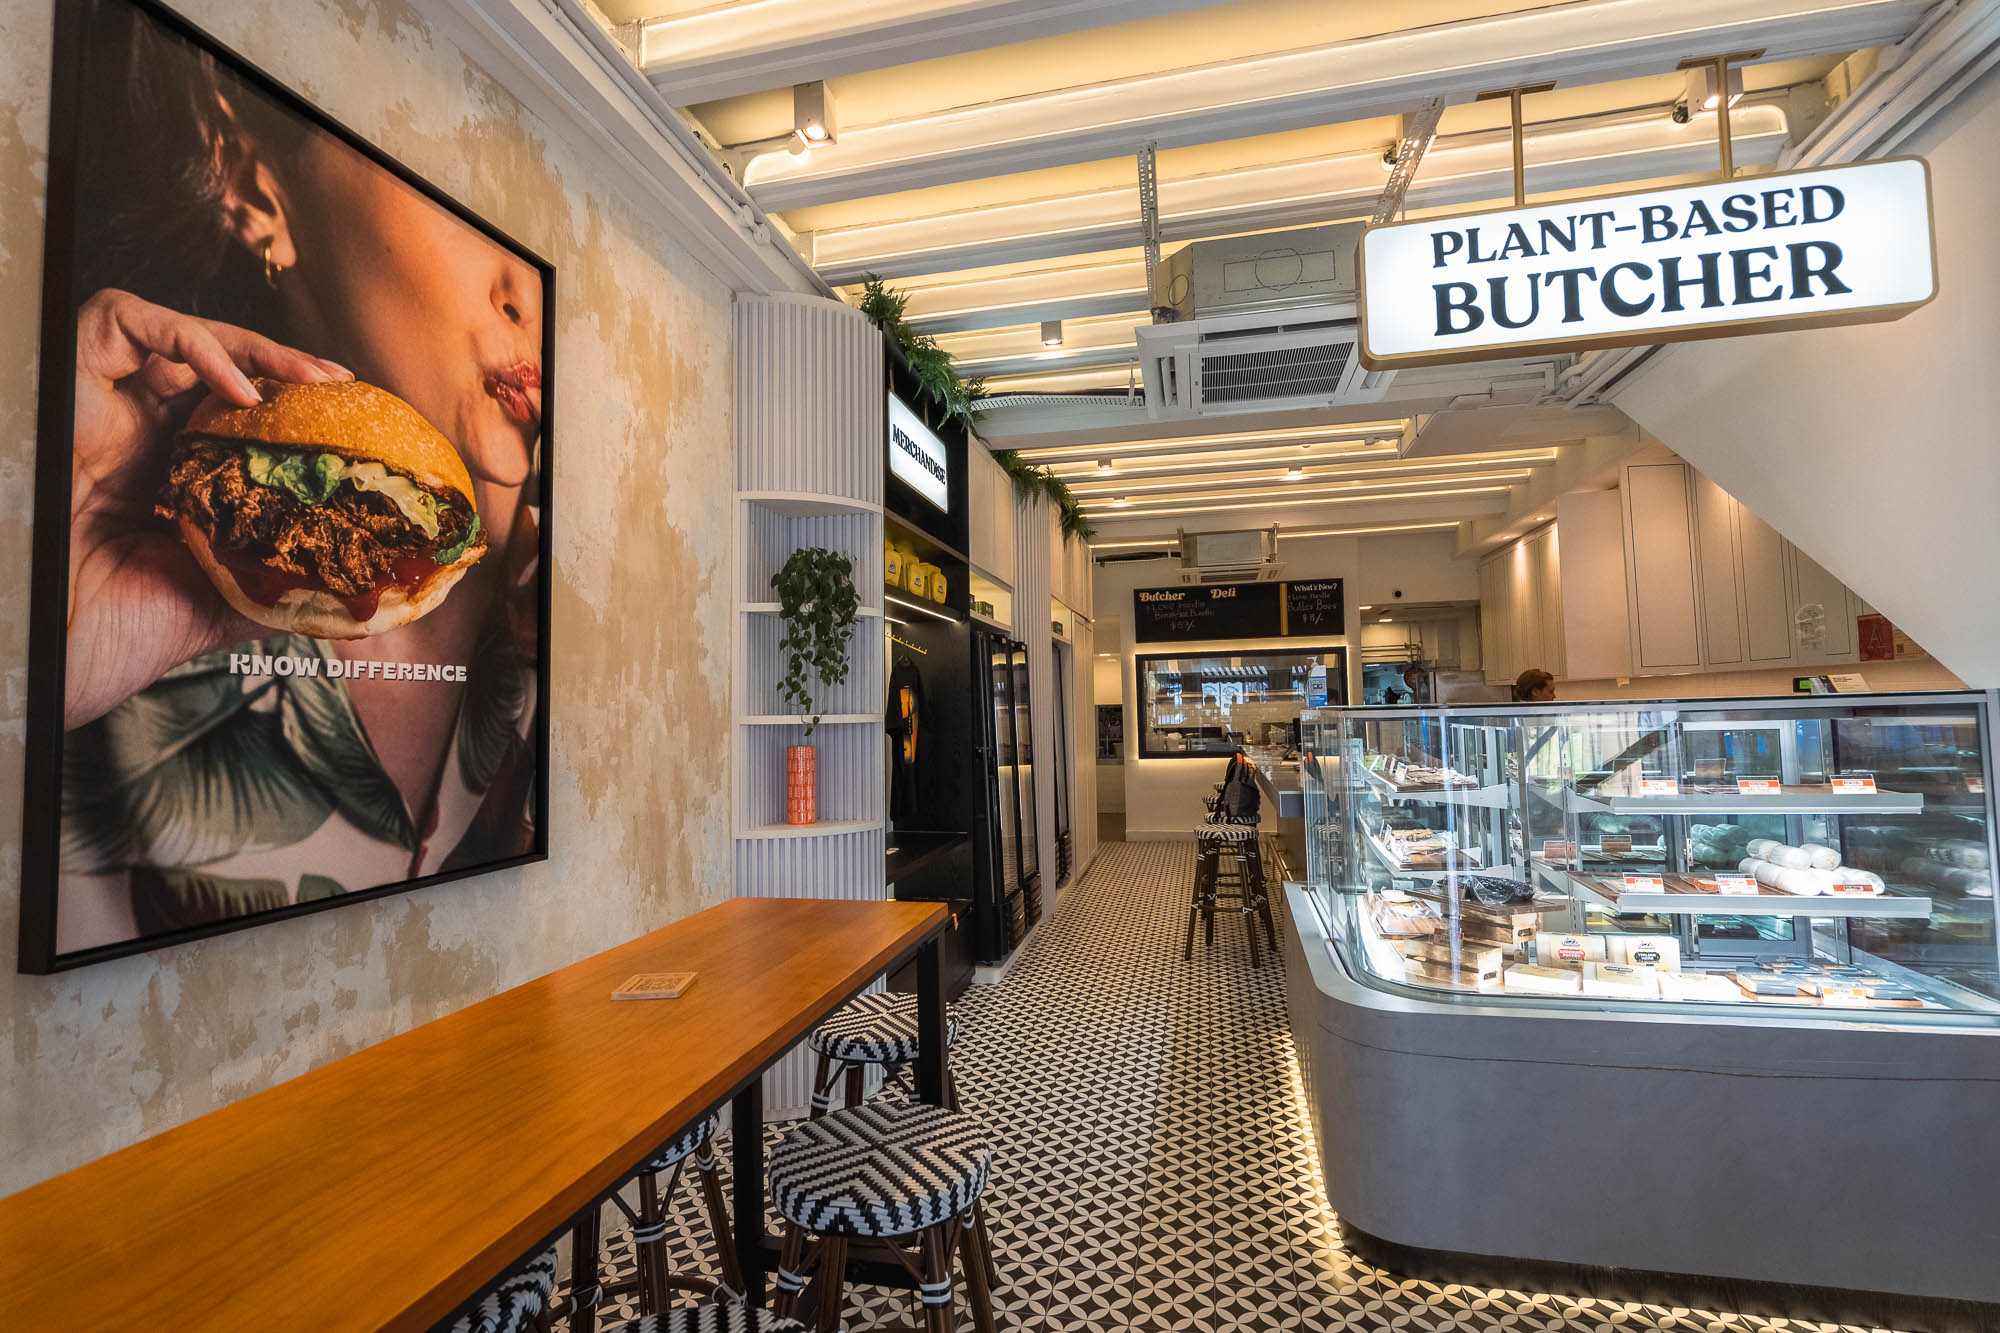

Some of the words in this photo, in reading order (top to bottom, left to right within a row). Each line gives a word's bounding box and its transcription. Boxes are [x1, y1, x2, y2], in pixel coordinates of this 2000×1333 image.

[1430, 184, 1846, 268] PLANT-BASED
[1431, 240, 1852, 336] BUTCHER
[1139, 591, 1186, 602] Butcher
[1210, 588, 1237, 599] Deli
[1319, 583, 1338, 591] New?
[229, 653, 321, 677] KNOW
[326, 659, 467, 682] DIFFERENCE
